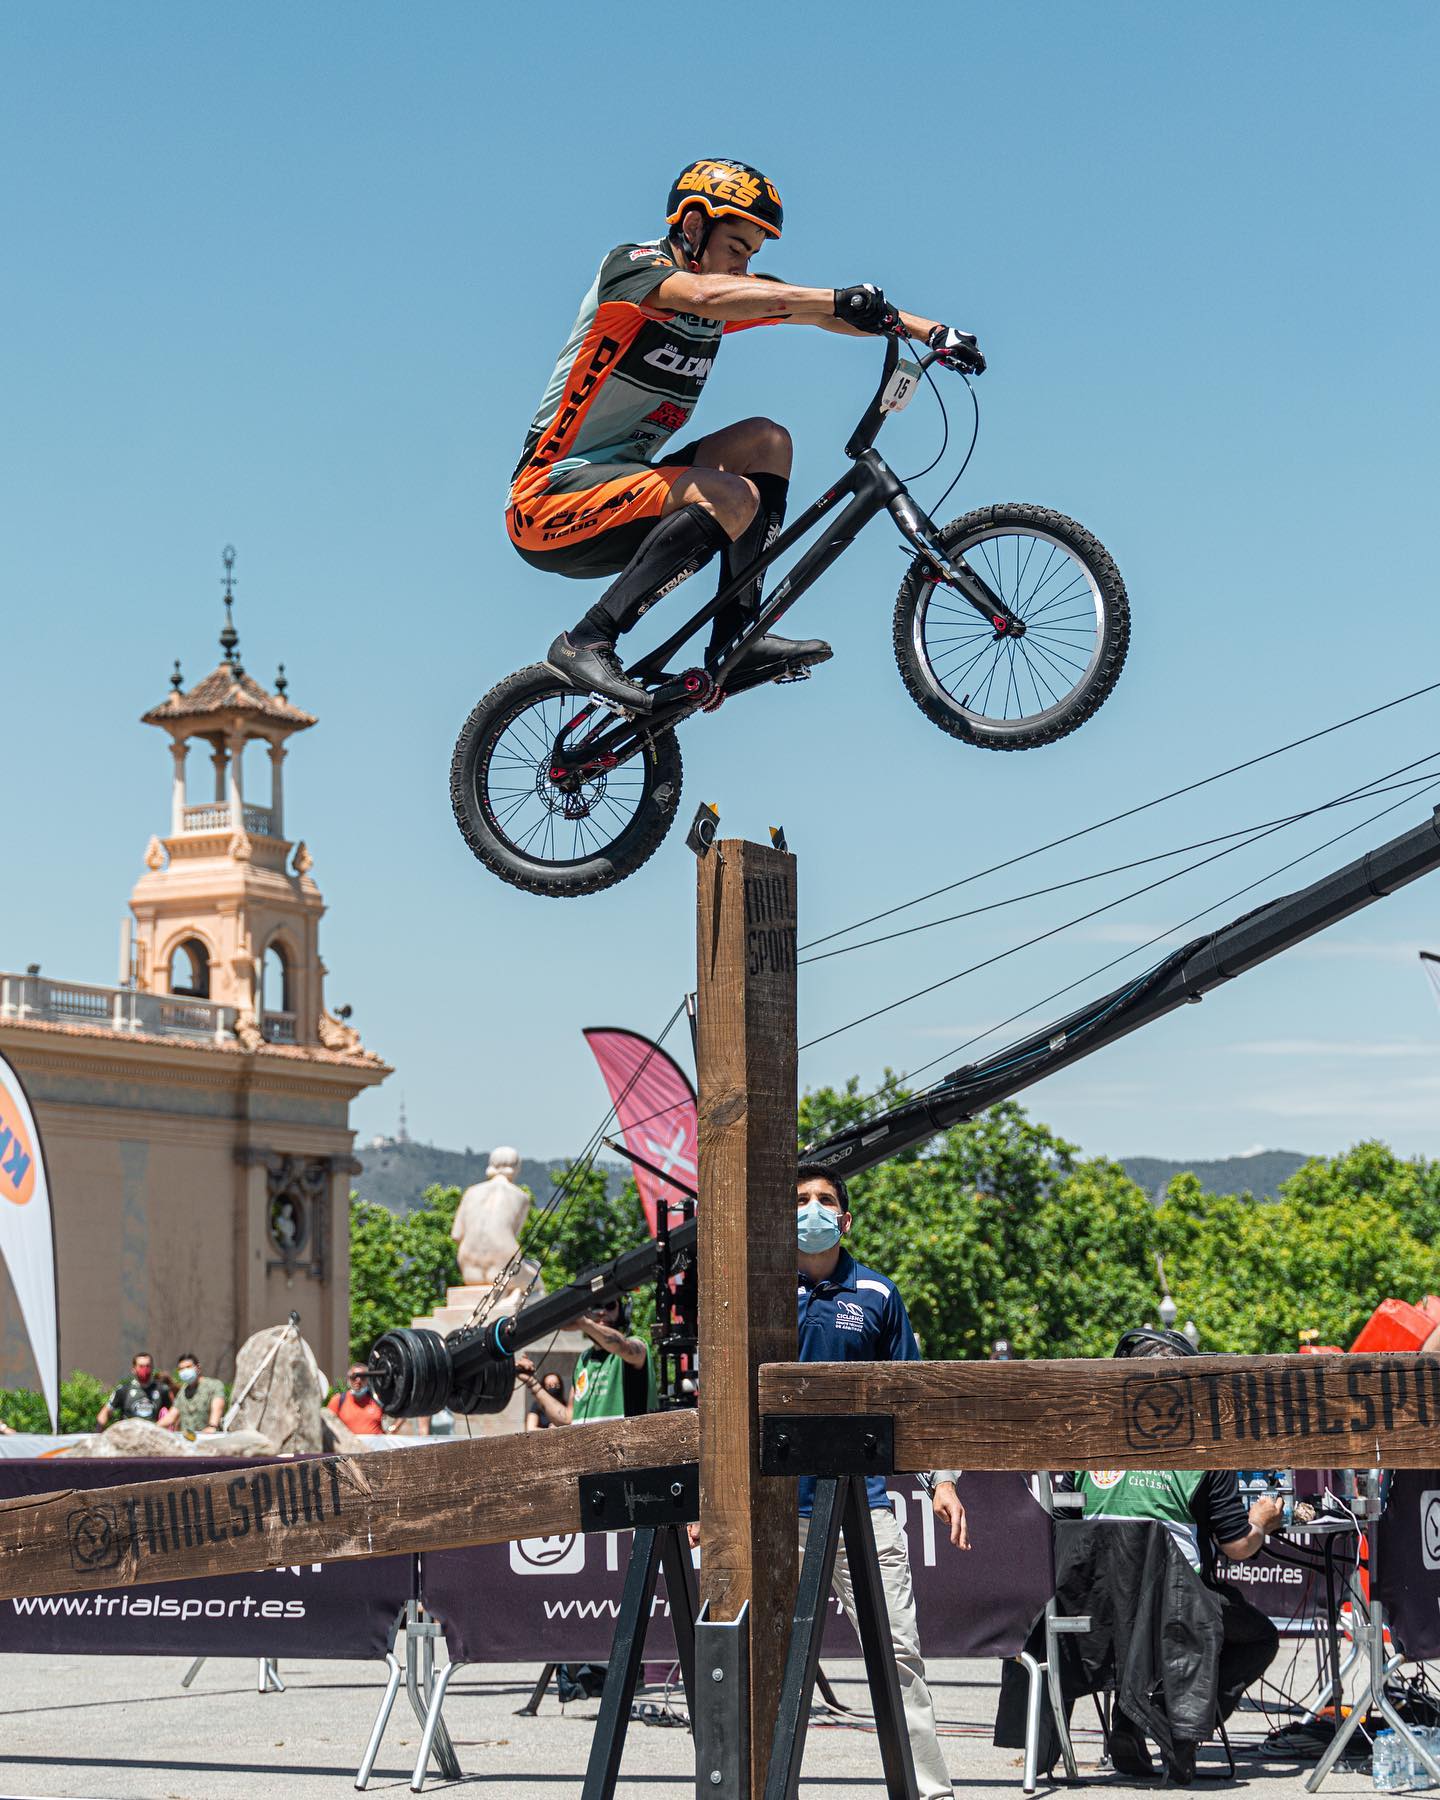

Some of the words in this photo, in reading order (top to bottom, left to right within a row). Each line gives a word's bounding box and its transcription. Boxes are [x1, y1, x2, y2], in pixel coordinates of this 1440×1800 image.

[677, 172, 757, 208] BIKES
[690, 160, 761, 197] TRIAL
[894, 376, 911, 399] 15
[542, 486, 646, 530] CLEAN
[656, 568, 694, 597] TRIAL
[13, 1594, 306, 1620] www.trialsport.es
